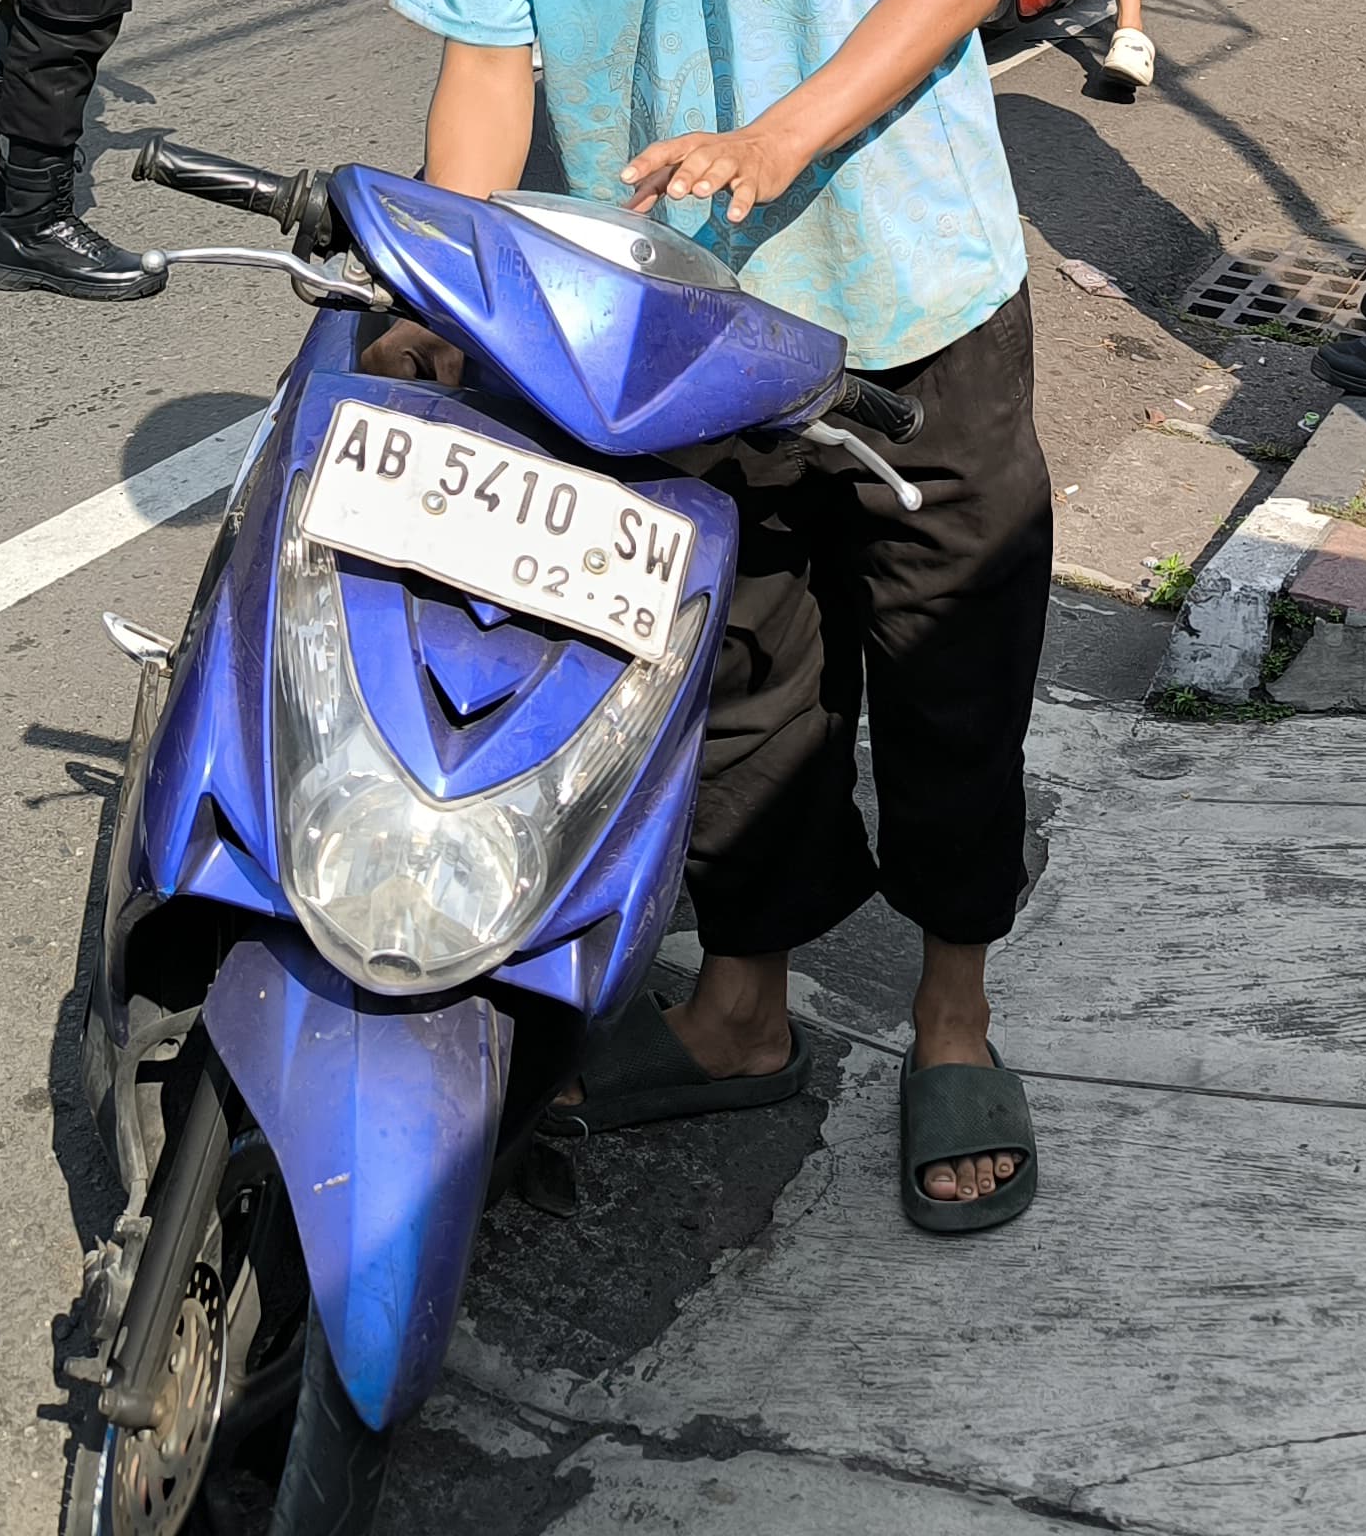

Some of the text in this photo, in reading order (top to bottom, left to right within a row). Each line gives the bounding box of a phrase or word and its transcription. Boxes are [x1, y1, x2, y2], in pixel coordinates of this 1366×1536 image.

[334, 418, 681, 583] AB 5410 SW
